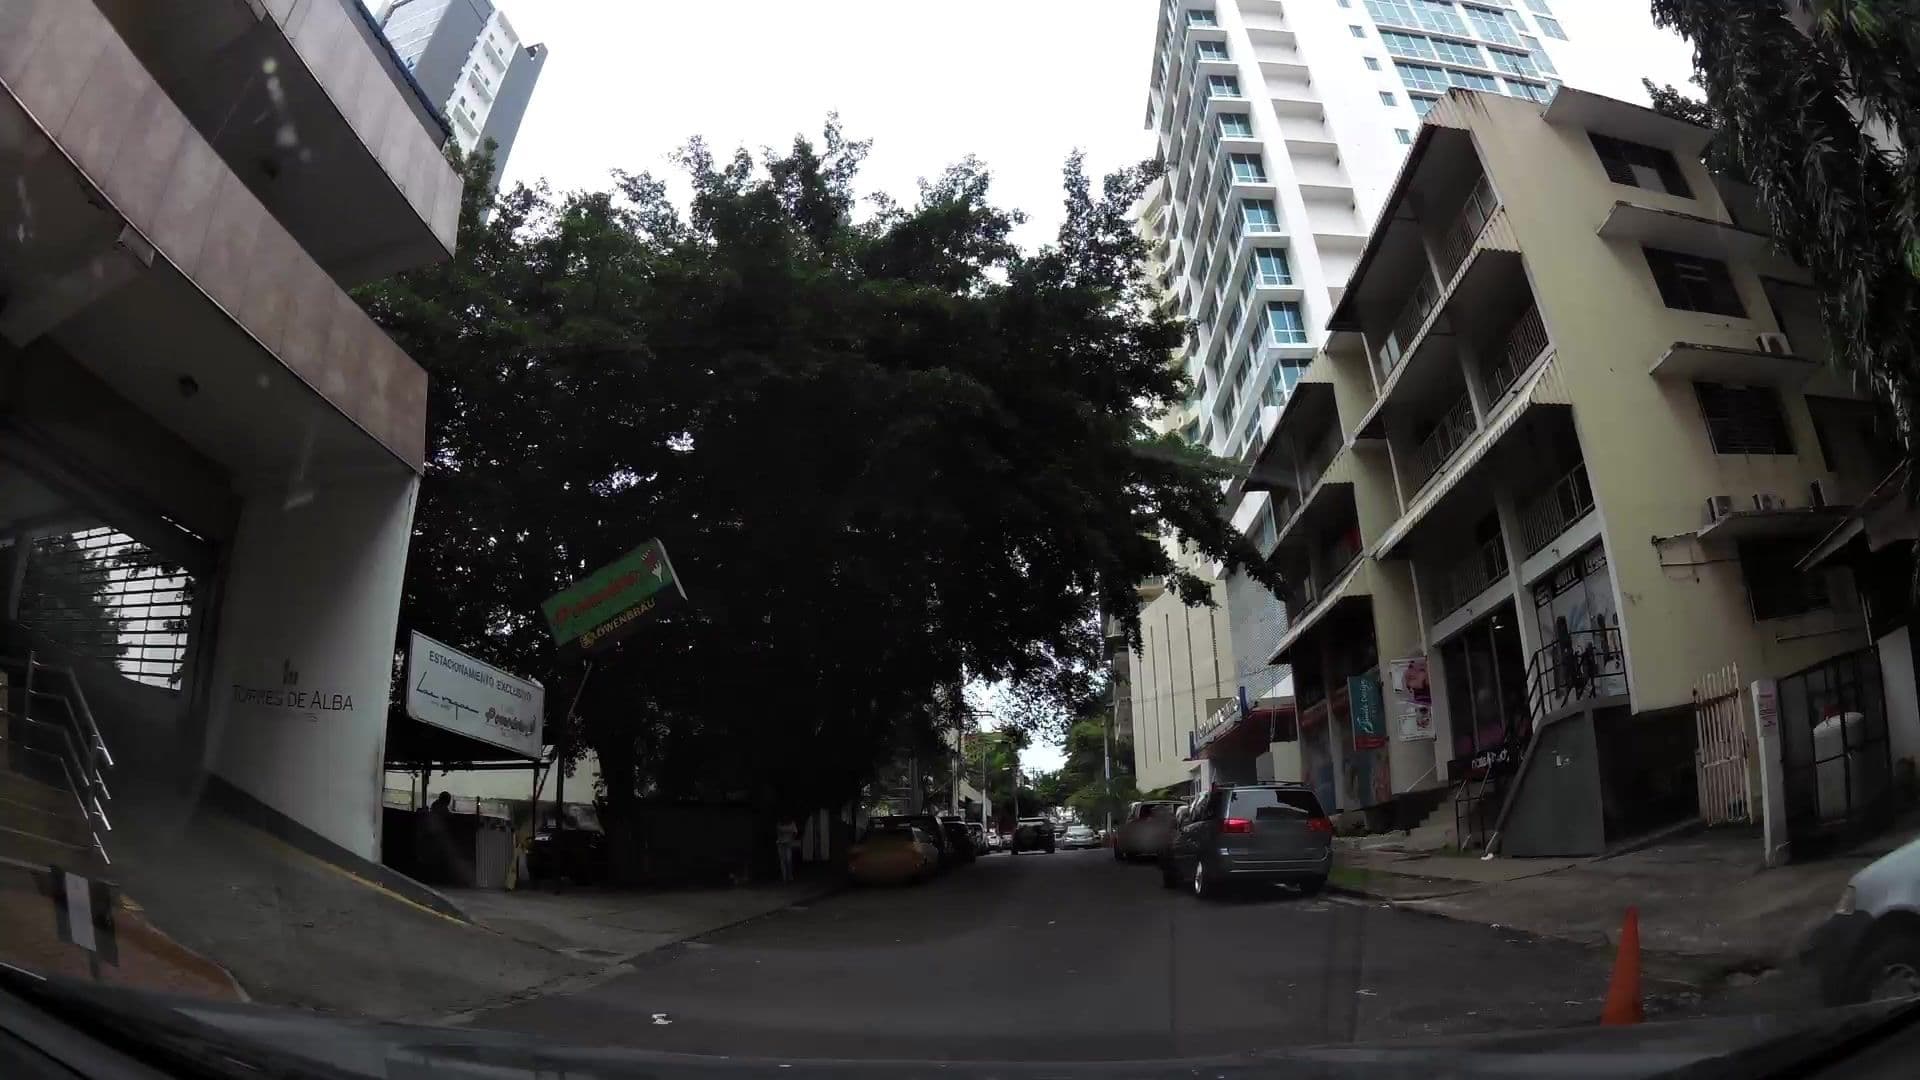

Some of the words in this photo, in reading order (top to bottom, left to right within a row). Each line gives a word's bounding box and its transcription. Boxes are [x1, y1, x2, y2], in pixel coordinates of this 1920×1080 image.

[429, 650, 495, 689] ESTACIONAMIENTO
[232, 684, 283, 706] TORRES
[287, 691, 308, 708] DE
[310, 690, 354, 711] ALBA
